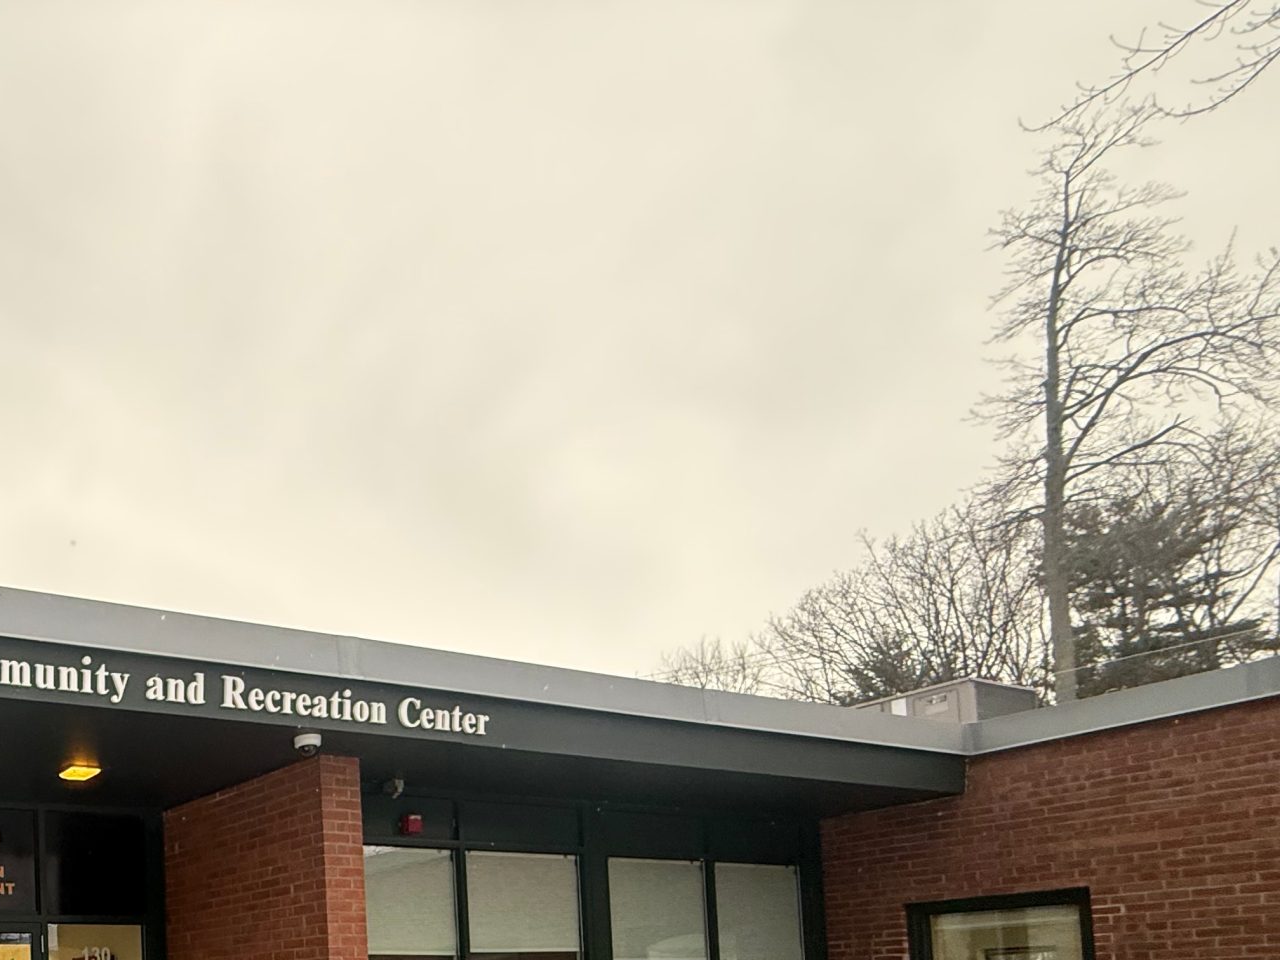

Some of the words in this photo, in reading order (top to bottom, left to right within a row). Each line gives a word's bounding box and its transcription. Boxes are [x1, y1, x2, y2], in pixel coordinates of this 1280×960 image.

[146, 672, 205, 704] and
[221, 674, 387, 725] Recreation
[398, 697, 490, 735] Center
